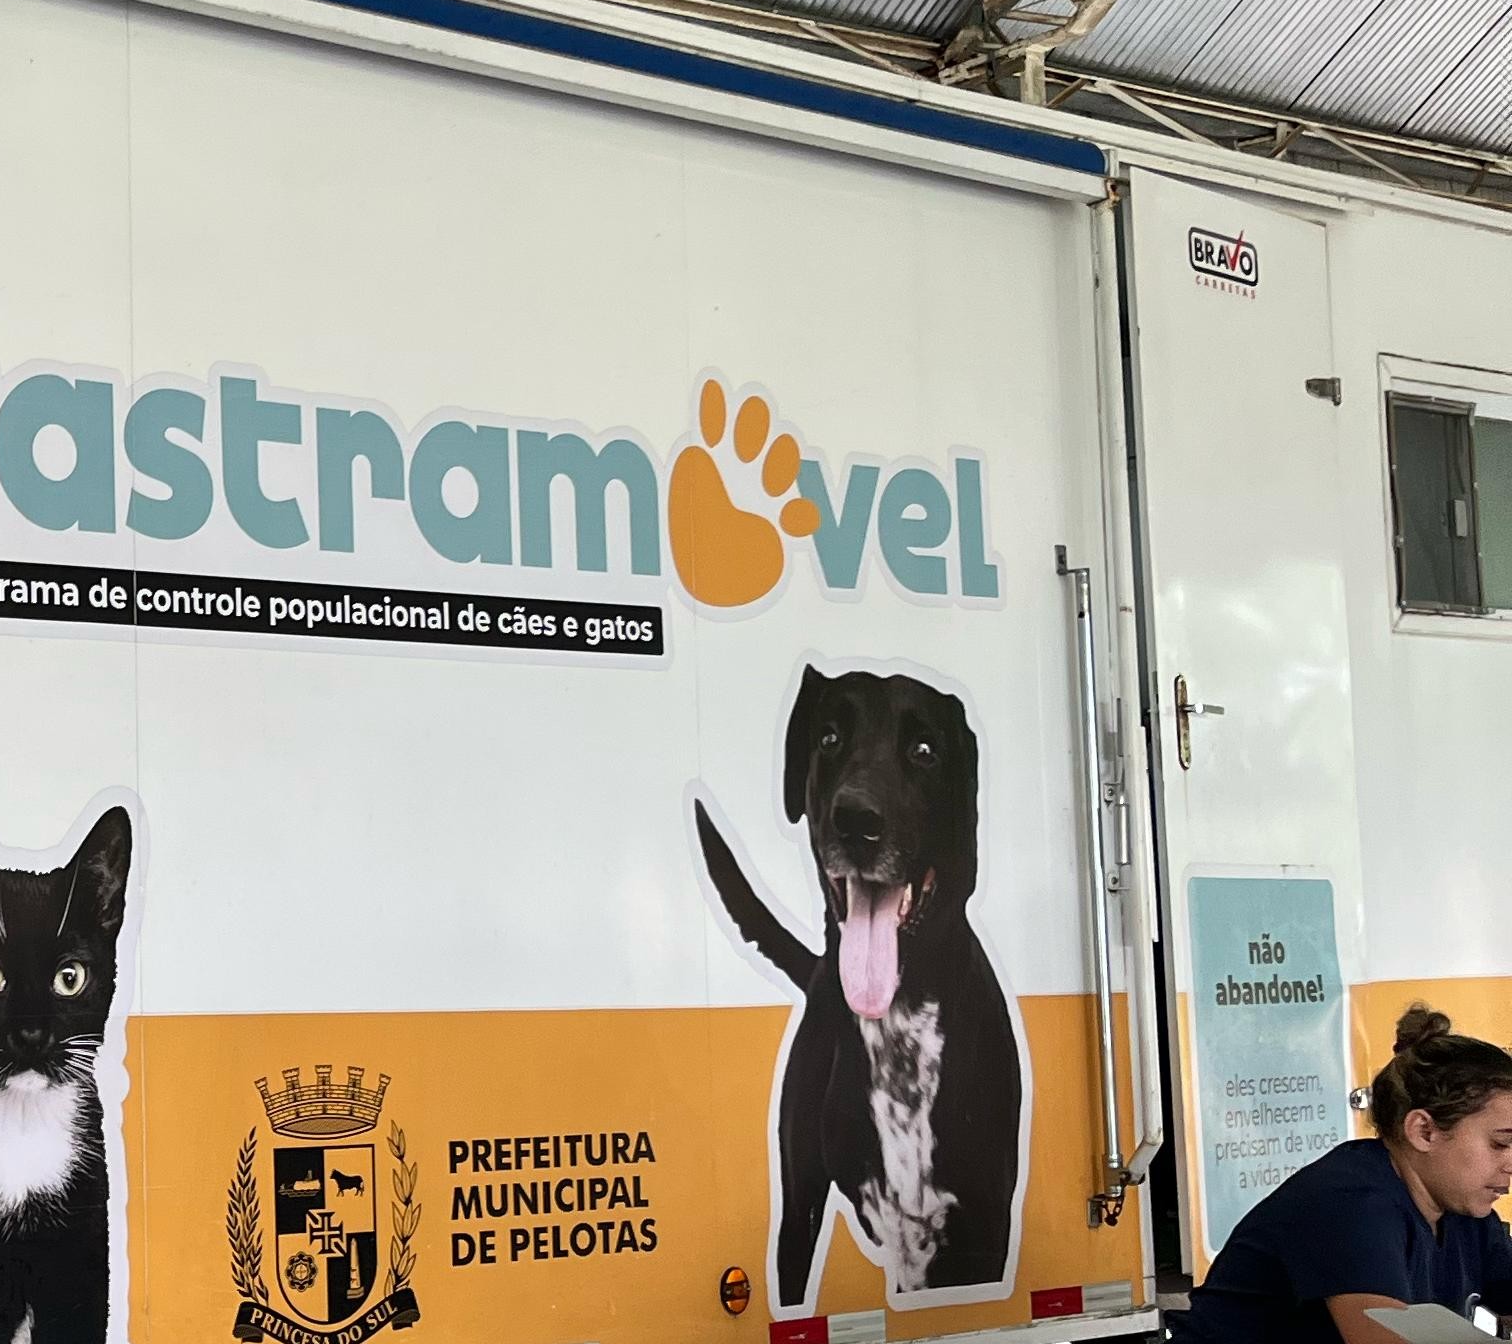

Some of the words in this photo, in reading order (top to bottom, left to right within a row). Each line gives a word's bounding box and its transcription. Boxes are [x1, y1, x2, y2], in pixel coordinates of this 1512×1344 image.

[1194, 230, 1253, 276] BRAVO
[1195, 275, 1256, 300] CARRETAS
[88, 577, 128, 609] de
[136, 587, 261, 618] controle
[269, 594, 450, 630] populacional
[457, 603, 491, 633] de
[497, 606, 557, 637] cães
[563, 615, 578, 638] e
[585, 615, 654, 646] gatos
[1248, 933, 1286, 965] não
[1215, 974, 1325, 1005] abandone!
[1226, 1073, 1256, 1097] eles
[1259, 1075, 1323, 1095] crescem,
[1225, 1102, 1314, 1129] envelhecem
[1317, 1104, 1326, 1120] e
[448, 1131, 656, 1174] PREFEITURA
[1215, 1134, 1282, 1166] precisam
[1284, 1130, 1303, 1153] de
[1305, 1126, 1339, 1151] você
[1239, 1171, 1247, 1189] a
[1250, 1162, 1281, 1188] vida
[451, 1176, 649, 1221] MUNICIPAL
[451, 1230, 497, 1267] DE
[511, 1218, 658, 1262] PELOTAS
[365, 1300, 399, 1331] SUL
